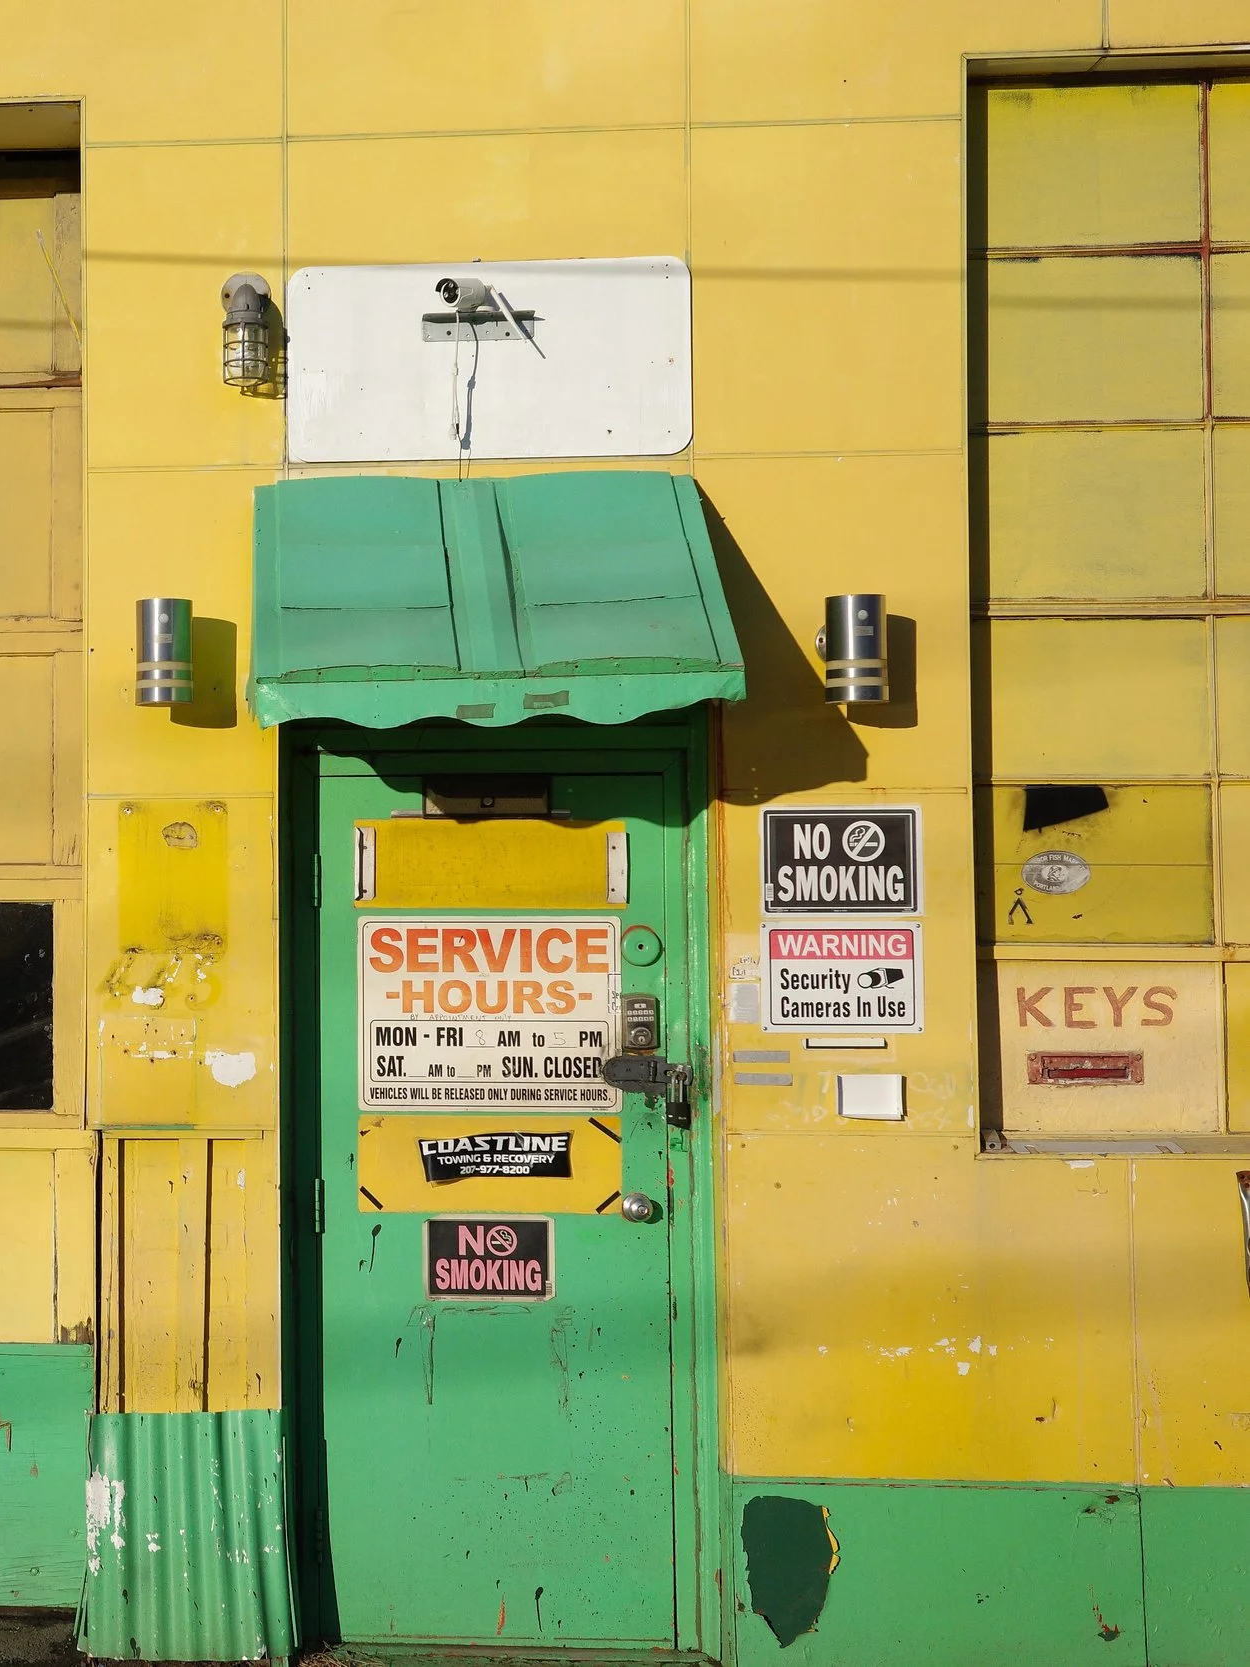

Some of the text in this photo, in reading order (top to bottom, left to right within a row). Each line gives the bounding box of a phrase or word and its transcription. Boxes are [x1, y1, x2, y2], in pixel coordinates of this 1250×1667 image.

[793, 823, 831, 860] NO
[777, 865, 905, 902] SMOKING
[369, 928, 610, 974] SERVICE
[777, 934, 908, 957] WARNING
[780, 968, 852, 994] Security
[780, 996, 907, 1019] Cameras In Use
[1016, 986, 1178, 1029] KEYS
[375, 1026, 418, 1047] MON
[436, 1027, 464, 1047] FRI
[475, 1029, 486, 1046] 8
[497, 1030, 521, 1047] AM
[532, 1032, 545, 1048] to
[552, 1031, 567, 1046] 5
[579, 1030, 603, 1048] PM
[376, 1055, 492, 1078] SAT. AM to PM
[501, 1056, 602, 1079] SUN. CLOSED
[369, 1087, 611, 1102] VEHICLES WILL BE RELEASED ONLY DURING SERVICE HOURS.
[420, 1135, 569, 1156] COASTLINE
[437, 1153, 555, 1166] TOWING & RECOVERY
[459, 1165, 531, 1175] 207-977-8200
[435, 1258, 542, 1291] SMOKING
